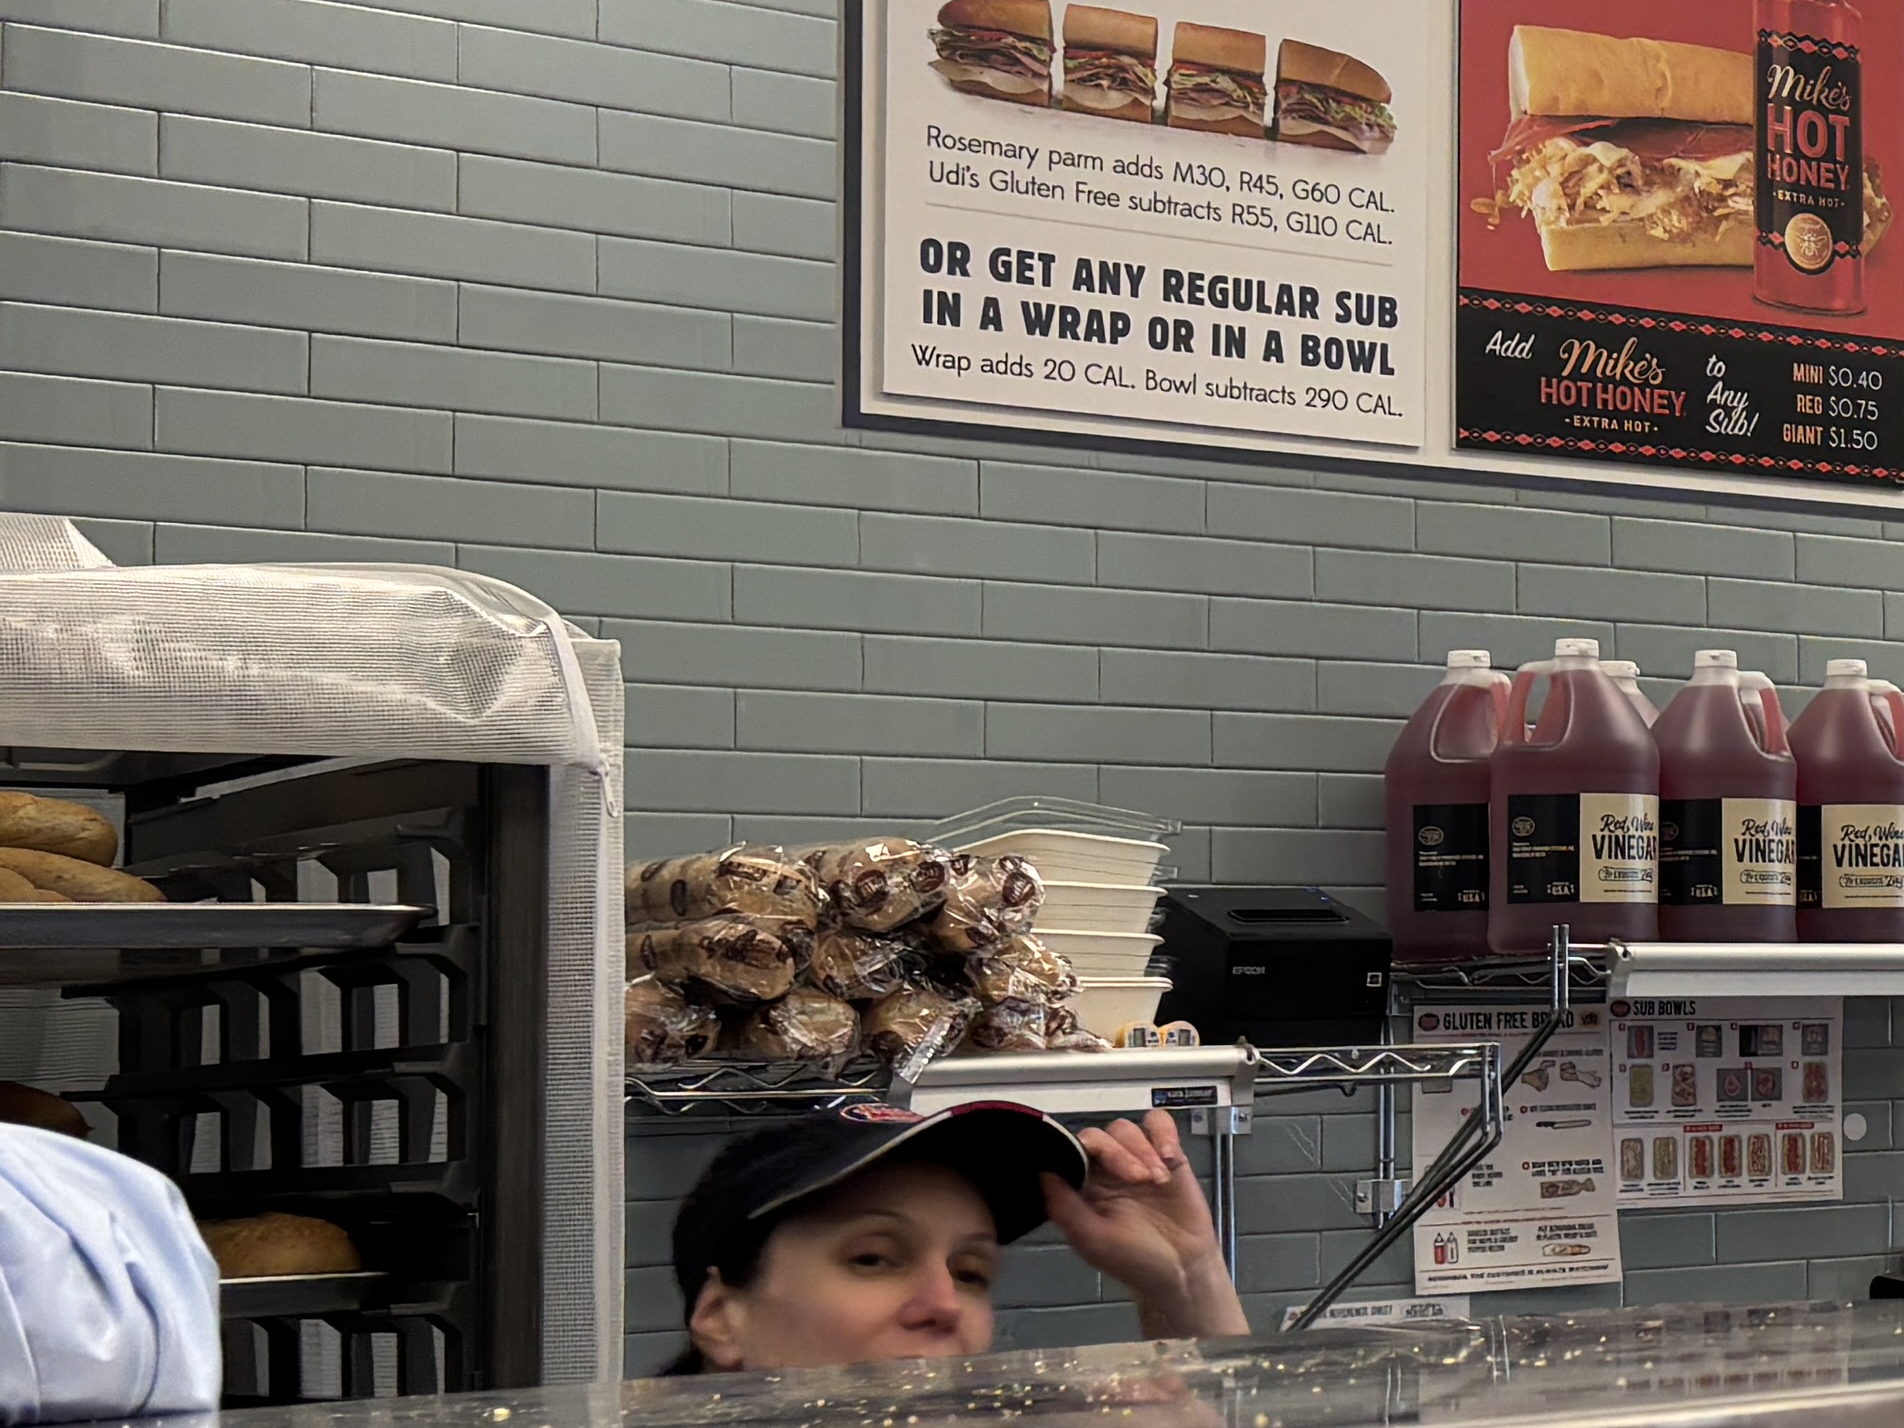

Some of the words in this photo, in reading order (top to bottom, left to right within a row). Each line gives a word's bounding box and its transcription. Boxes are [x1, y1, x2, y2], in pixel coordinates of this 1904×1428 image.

[1767, 103, 1851, 161] HOT
[1767, 152, 1849, 191] HONEY
[920, 238, 971, 277] OR
[989, 246, 1056, 287] GET
[1073, 258, 1146, 298] ANY
[1163, 269, 1319, 320] REGULAR
[1335, 291, 1398, 328] SUB
[1793, 363, 1823, 384] MINI
[1828, 366, 1883, 390] $0.40
[1443, 1012, 1493, 1030] GLUTEN
[1497, 1012, 1527, 1030] FREE
[1632, 1001, 1655, 1016] SUB
[1658, 1000, 1696, 1016] BOWLS
